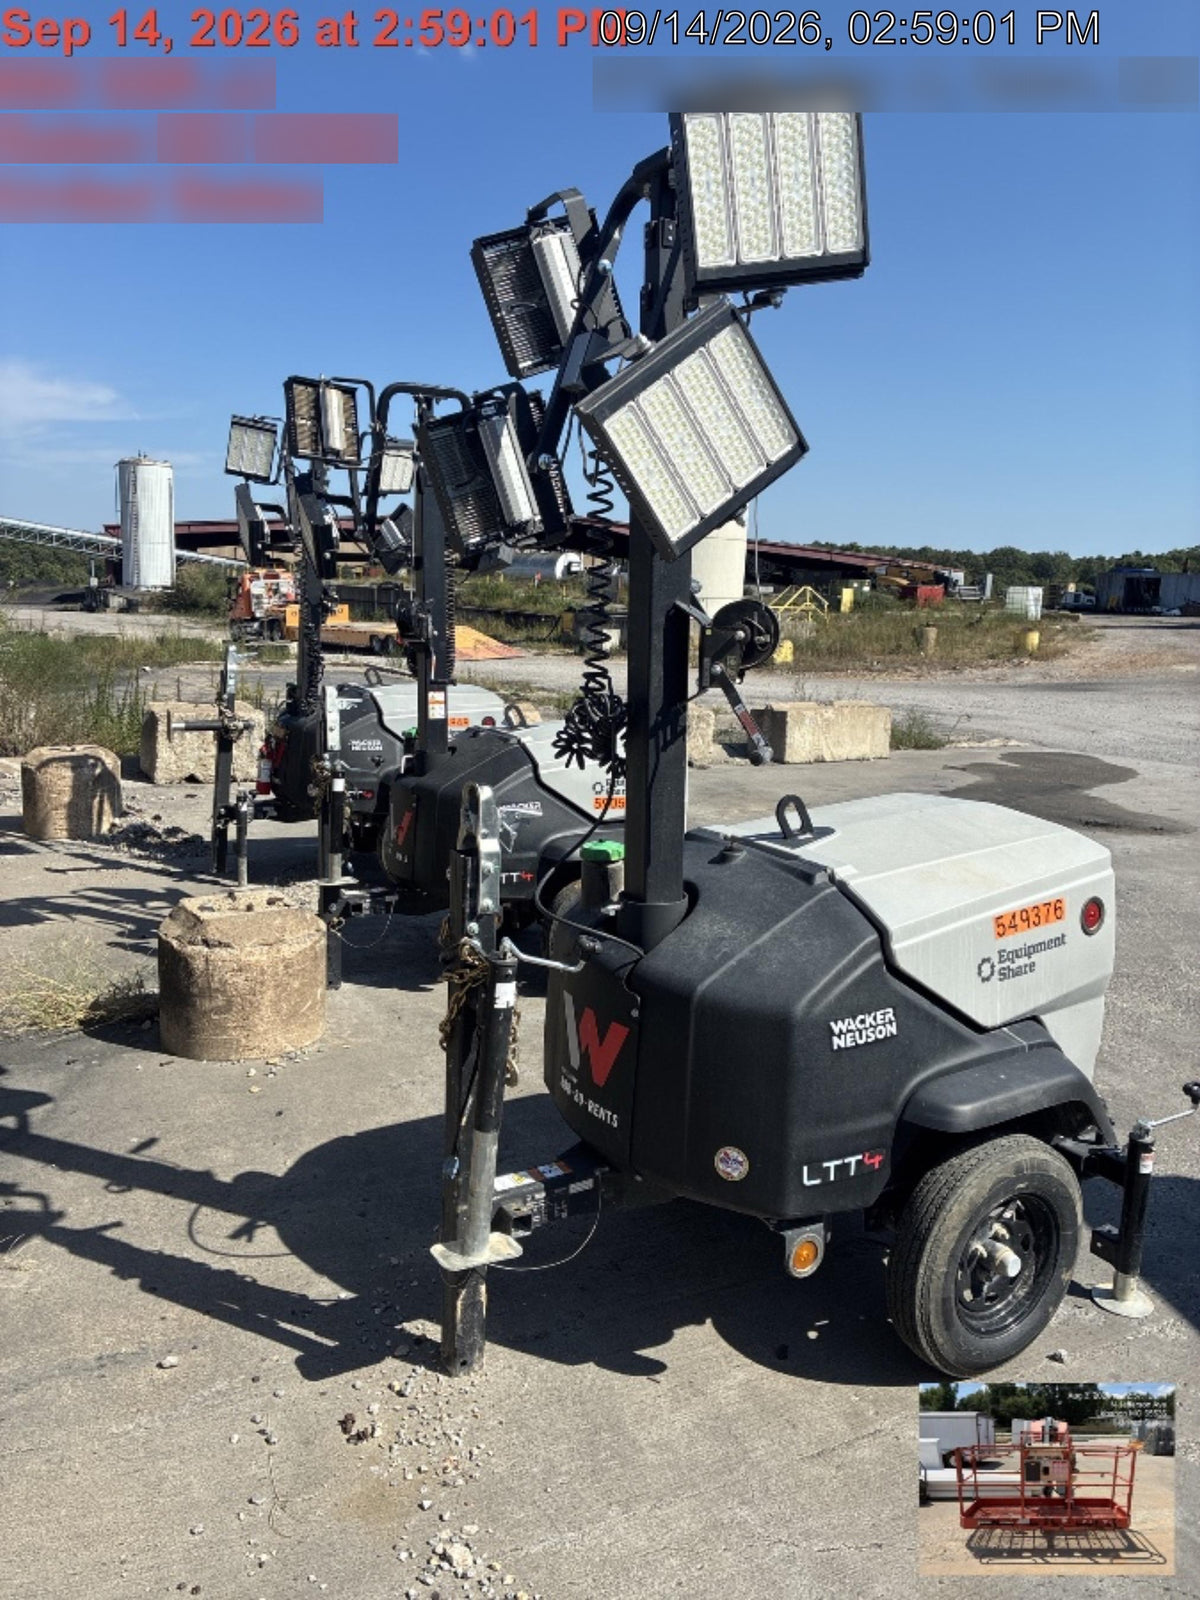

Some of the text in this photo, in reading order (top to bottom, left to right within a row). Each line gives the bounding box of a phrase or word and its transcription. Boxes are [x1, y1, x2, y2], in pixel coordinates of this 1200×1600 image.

[500, 871, 534, 884] TT4
[995, 898, 1064, 938] 549376
[997, 933, 1067, 964] Equipment
[998, 961, 1036, 982] Share
[830, 1007, 895, 1036] WACKER
[832, 1021, 897, 1051] NEUSON
[802, 1152, 884, 1187] LTT4
